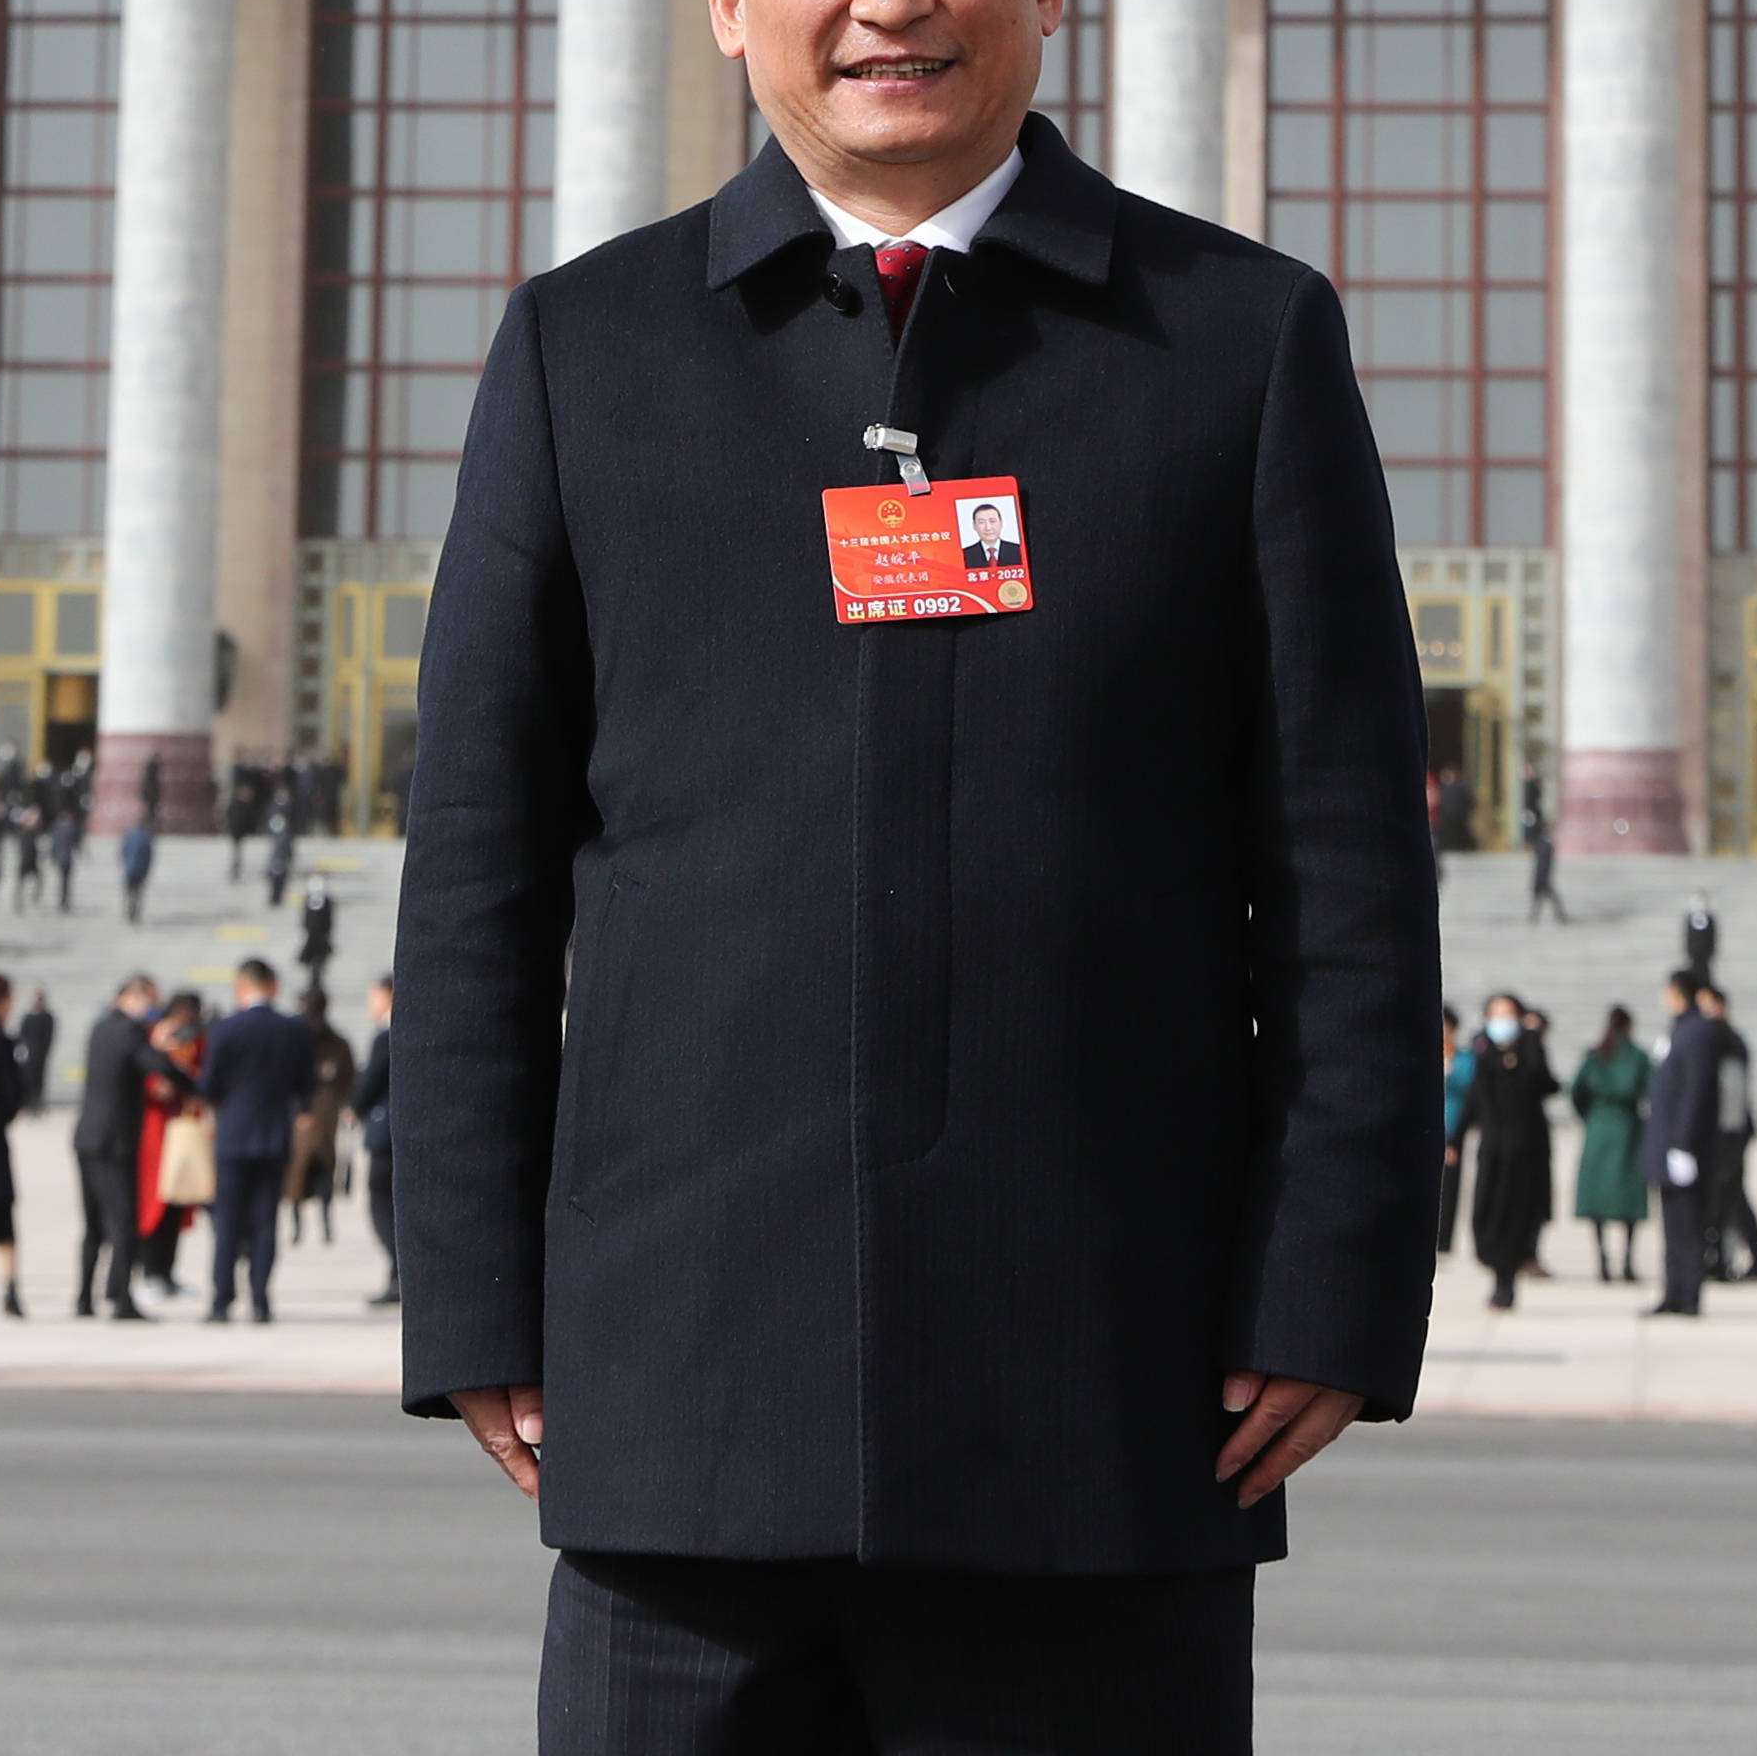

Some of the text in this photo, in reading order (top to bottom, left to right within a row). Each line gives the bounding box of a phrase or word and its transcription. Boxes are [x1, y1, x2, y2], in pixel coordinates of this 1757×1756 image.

[839, 531, 951, 548] 十三届全国人大五次会议
[846, 596, 962, 620] 出席证 0992
